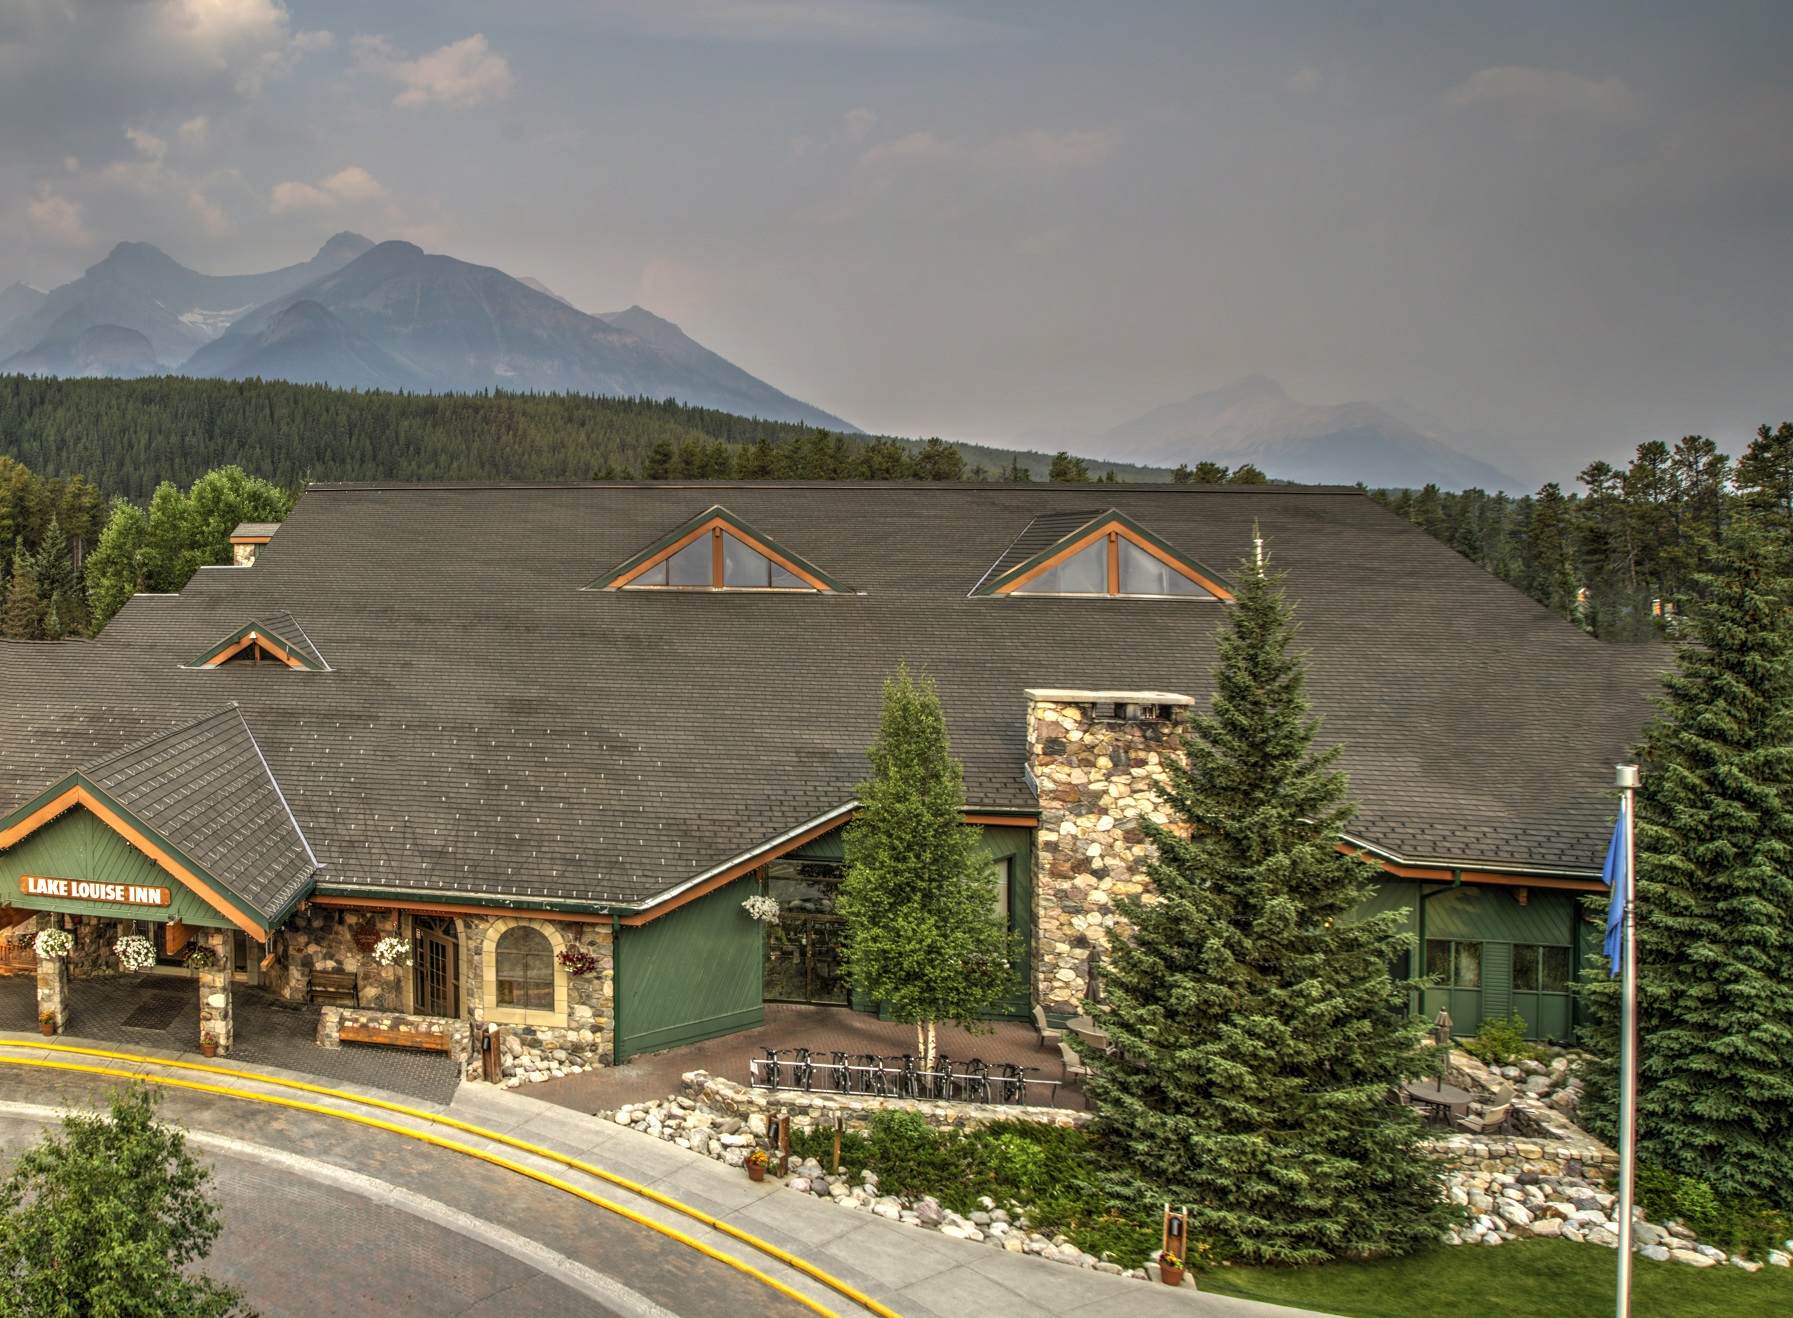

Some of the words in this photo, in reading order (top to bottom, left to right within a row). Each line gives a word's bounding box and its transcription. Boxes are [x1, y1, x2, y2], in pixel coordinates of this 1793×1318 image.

[28, 877, 68, 896] LAKE
[71, 881, 125, 901] LOUISE
[129, 886, 161, 904] INN
